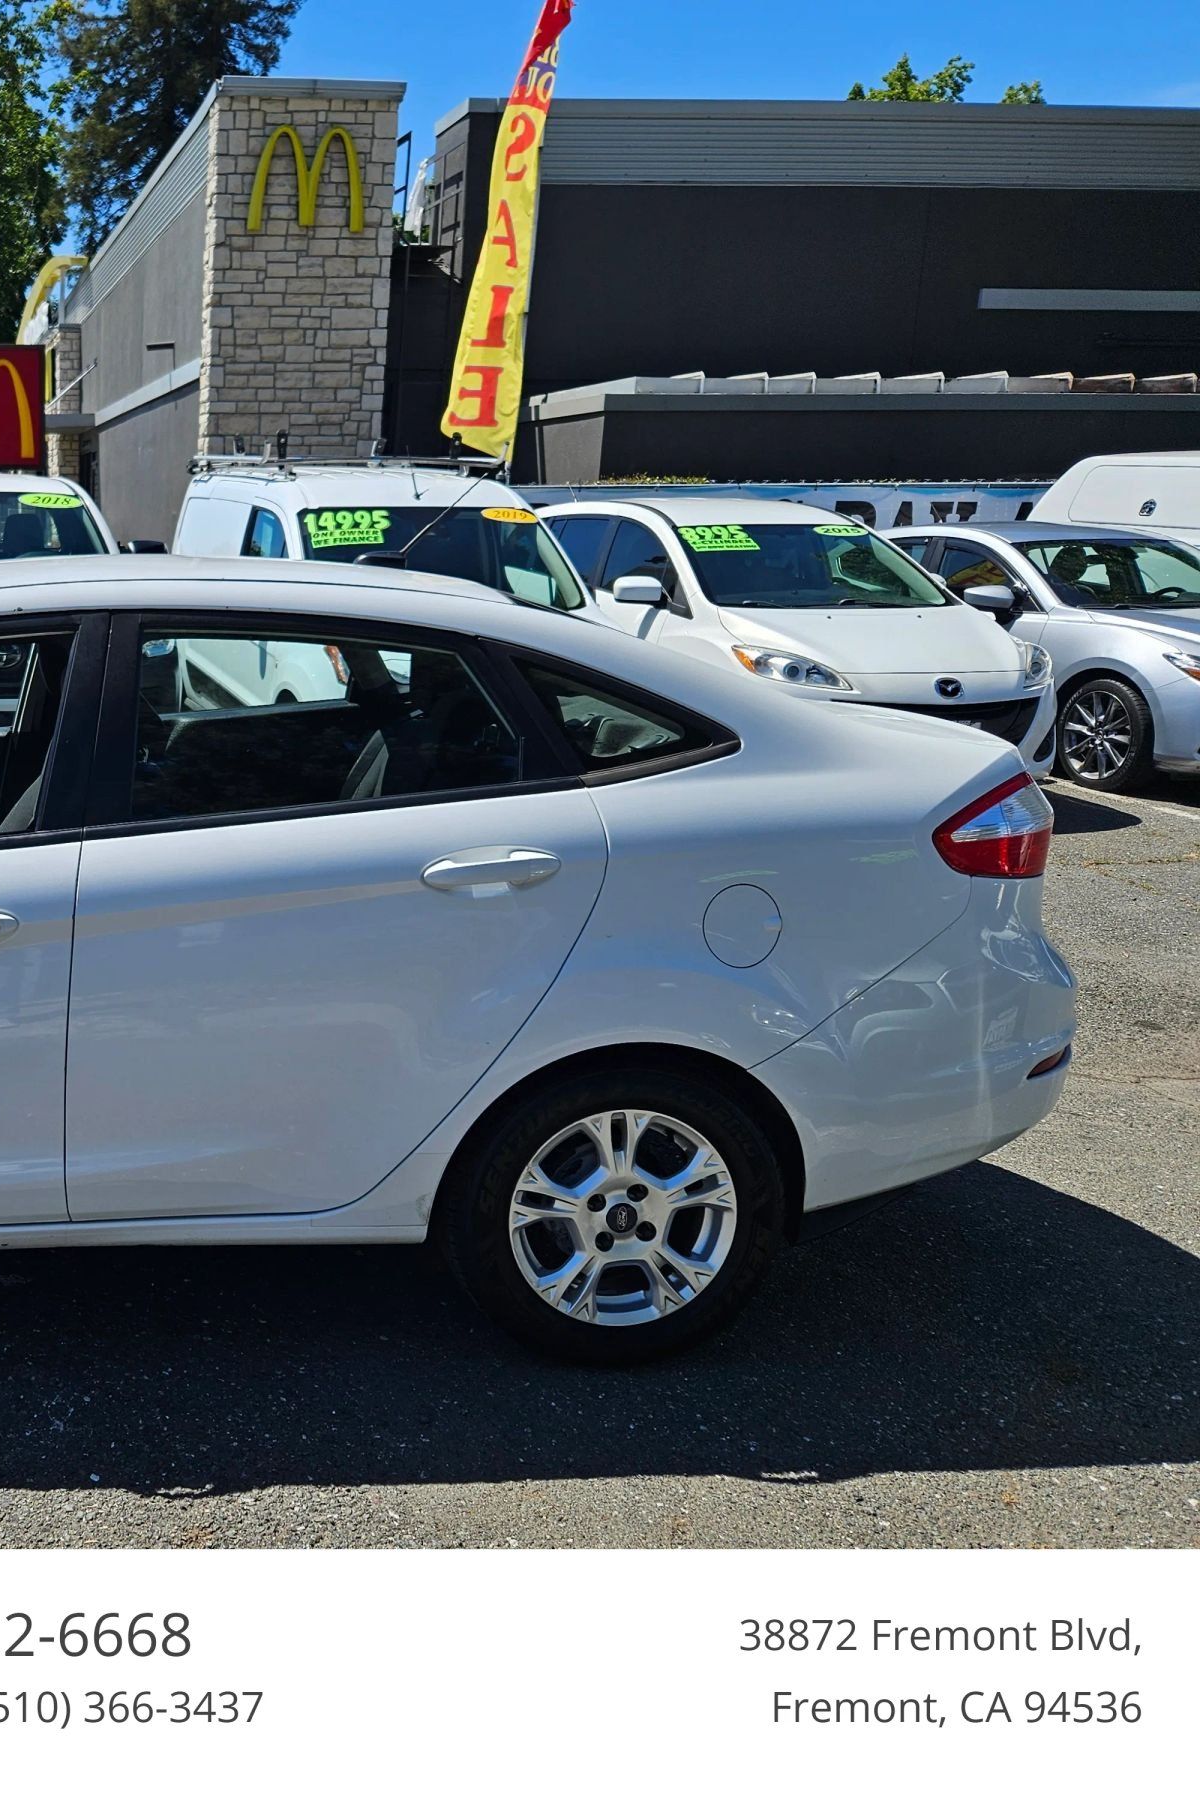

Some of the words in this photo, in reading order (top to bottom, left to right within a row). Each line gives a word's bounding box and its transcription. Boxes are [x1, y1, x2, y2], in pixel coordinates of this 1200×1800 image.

[31, 495, 72, 506] 2018
[493, 509, 528, 521] 2019
[304, 509, 391, 534] 14995
[312, 531, 336, 539] ONE
[338, 529, 379, 538] OWNER
[677, 525, 749, 541] 8995
[822, 526, 861, 535] 2015
[312, 538, 331, 546] WE
[332, 535, 381, 544] FINANCE
